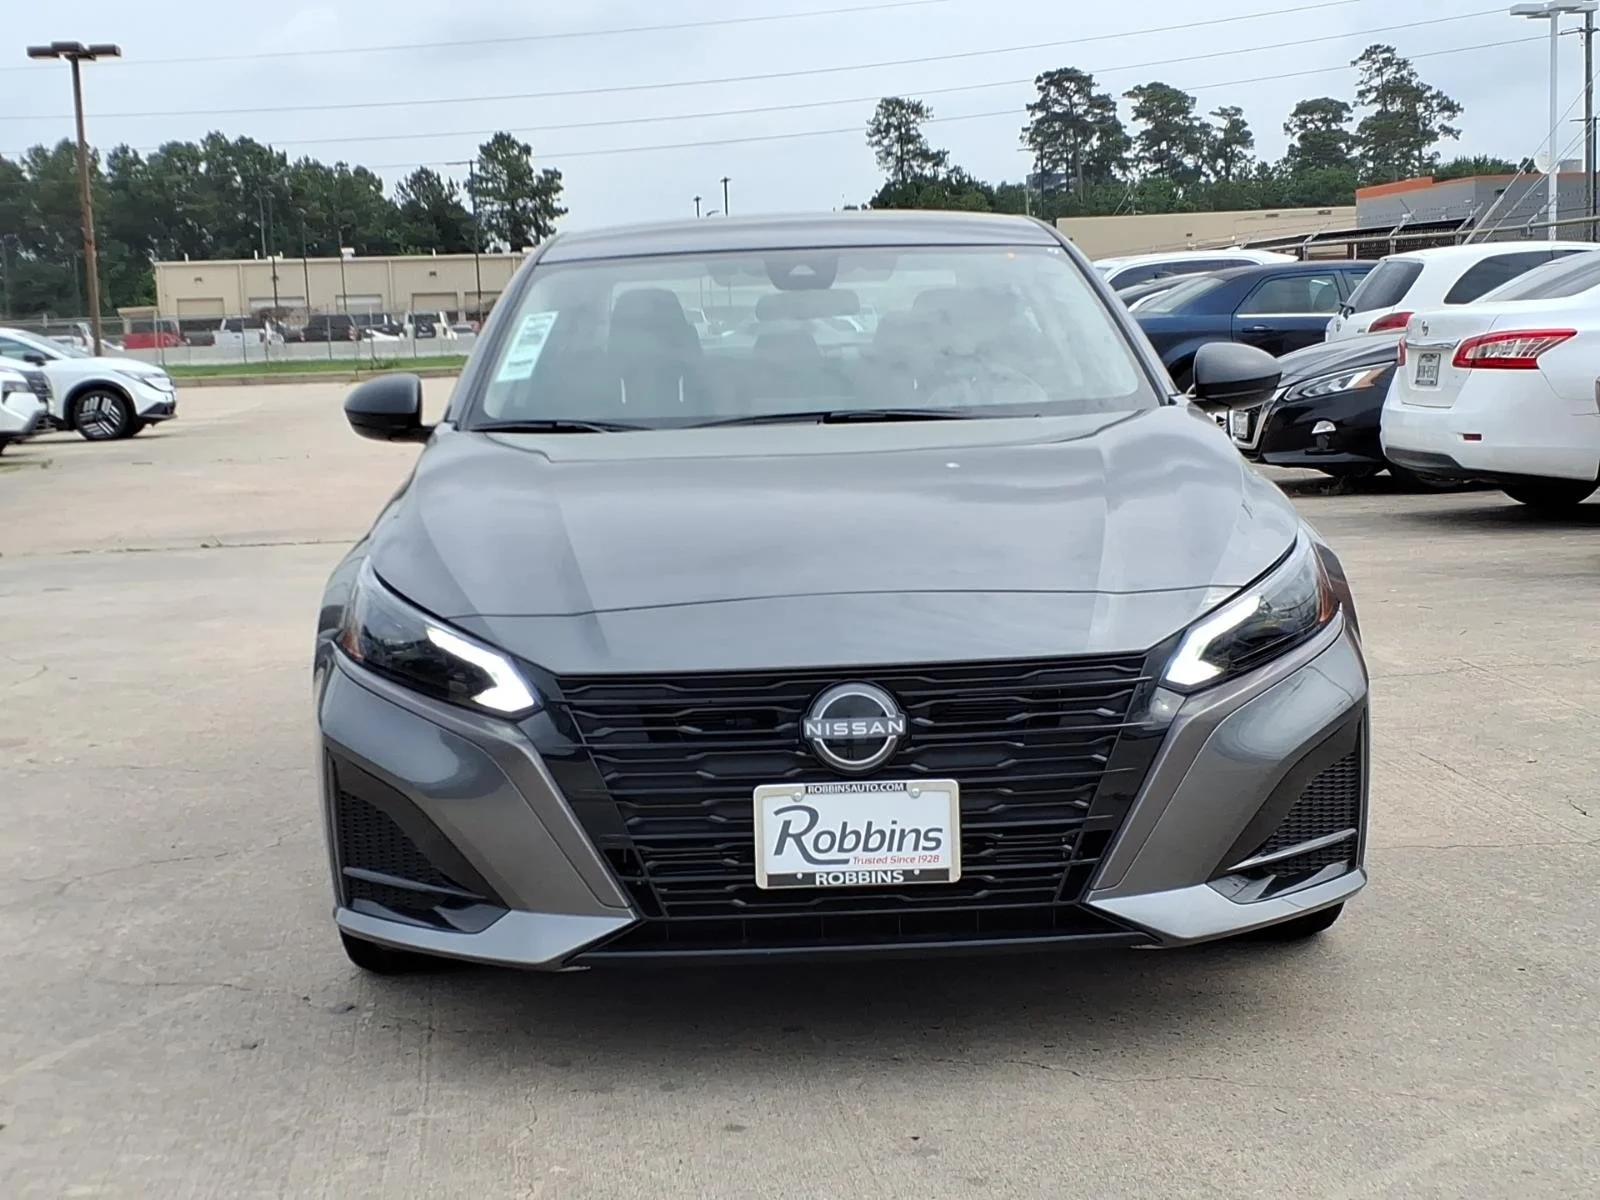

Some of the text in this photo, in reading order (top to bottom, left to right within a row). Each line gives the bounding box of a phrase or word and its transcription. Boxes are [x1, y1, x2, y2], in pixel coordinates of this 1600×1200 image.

[806, 720, 904, 736] NISSAN
[807, 783, 905, 795] ROBBINSAUTO.COM
[773, 804, 944, 866] Robbins
[853, 854, 940, 865] Trusted Since 1928
[815, 869, 905, 886] ROBBINS
